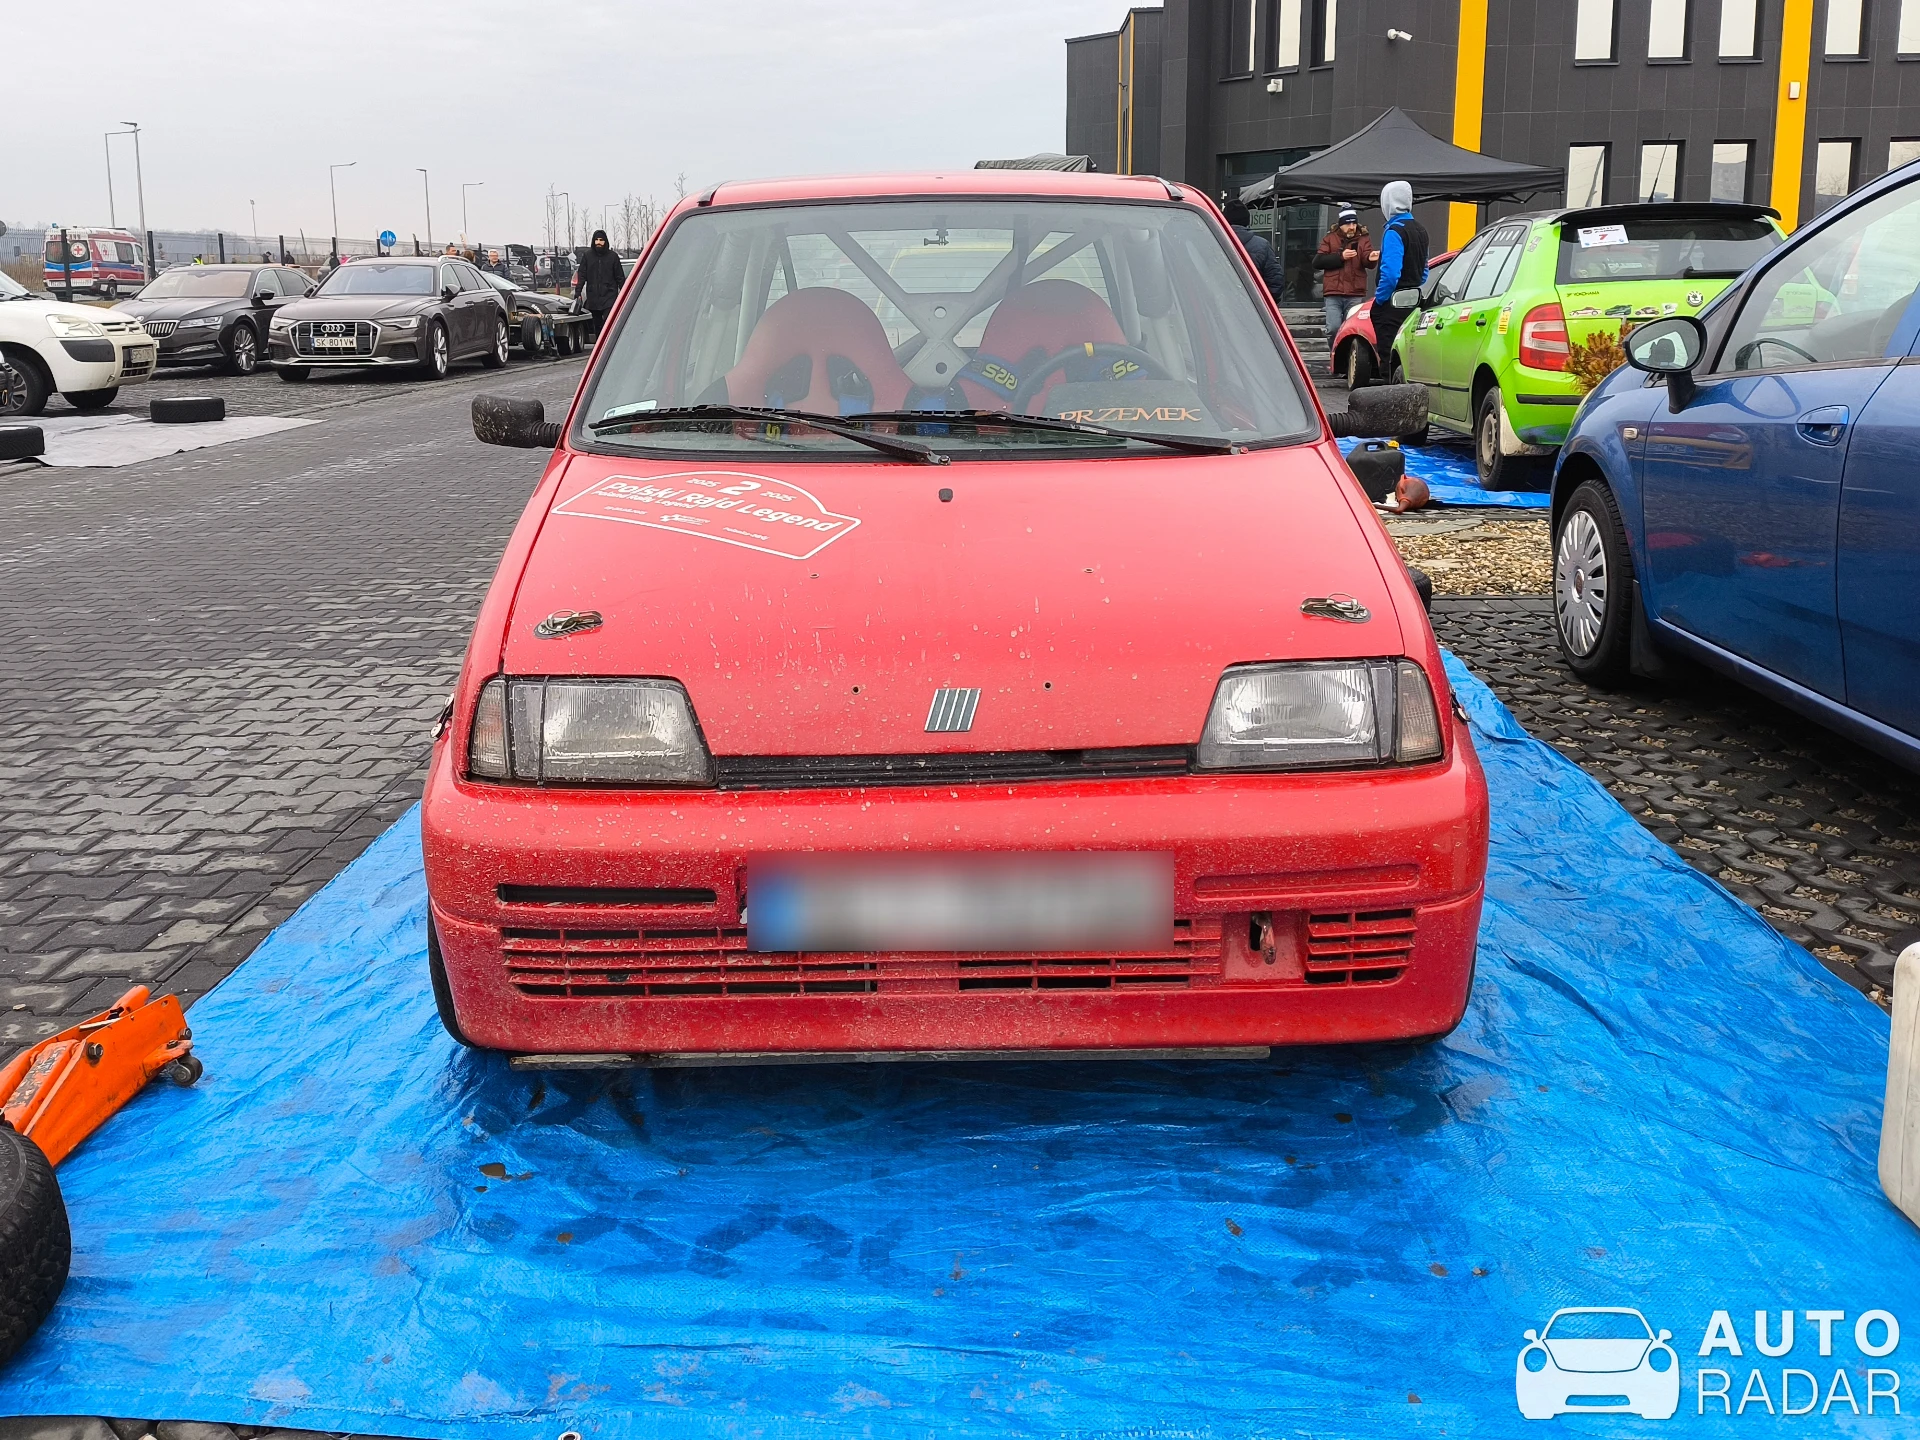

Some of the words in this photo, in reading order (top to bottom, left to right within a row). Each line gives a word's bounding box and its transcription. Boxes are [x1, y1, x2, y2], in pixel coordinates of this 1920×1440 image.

[1250, 211, 1272, 226] JŚCIE
[316, 338, 326, 347] SK
[717, 480, 762, 496] 2
[600, 482, 686, 499] Polski
[677, 493, 745, 509] Rajd
[735, 503, 844, 532] Legend
